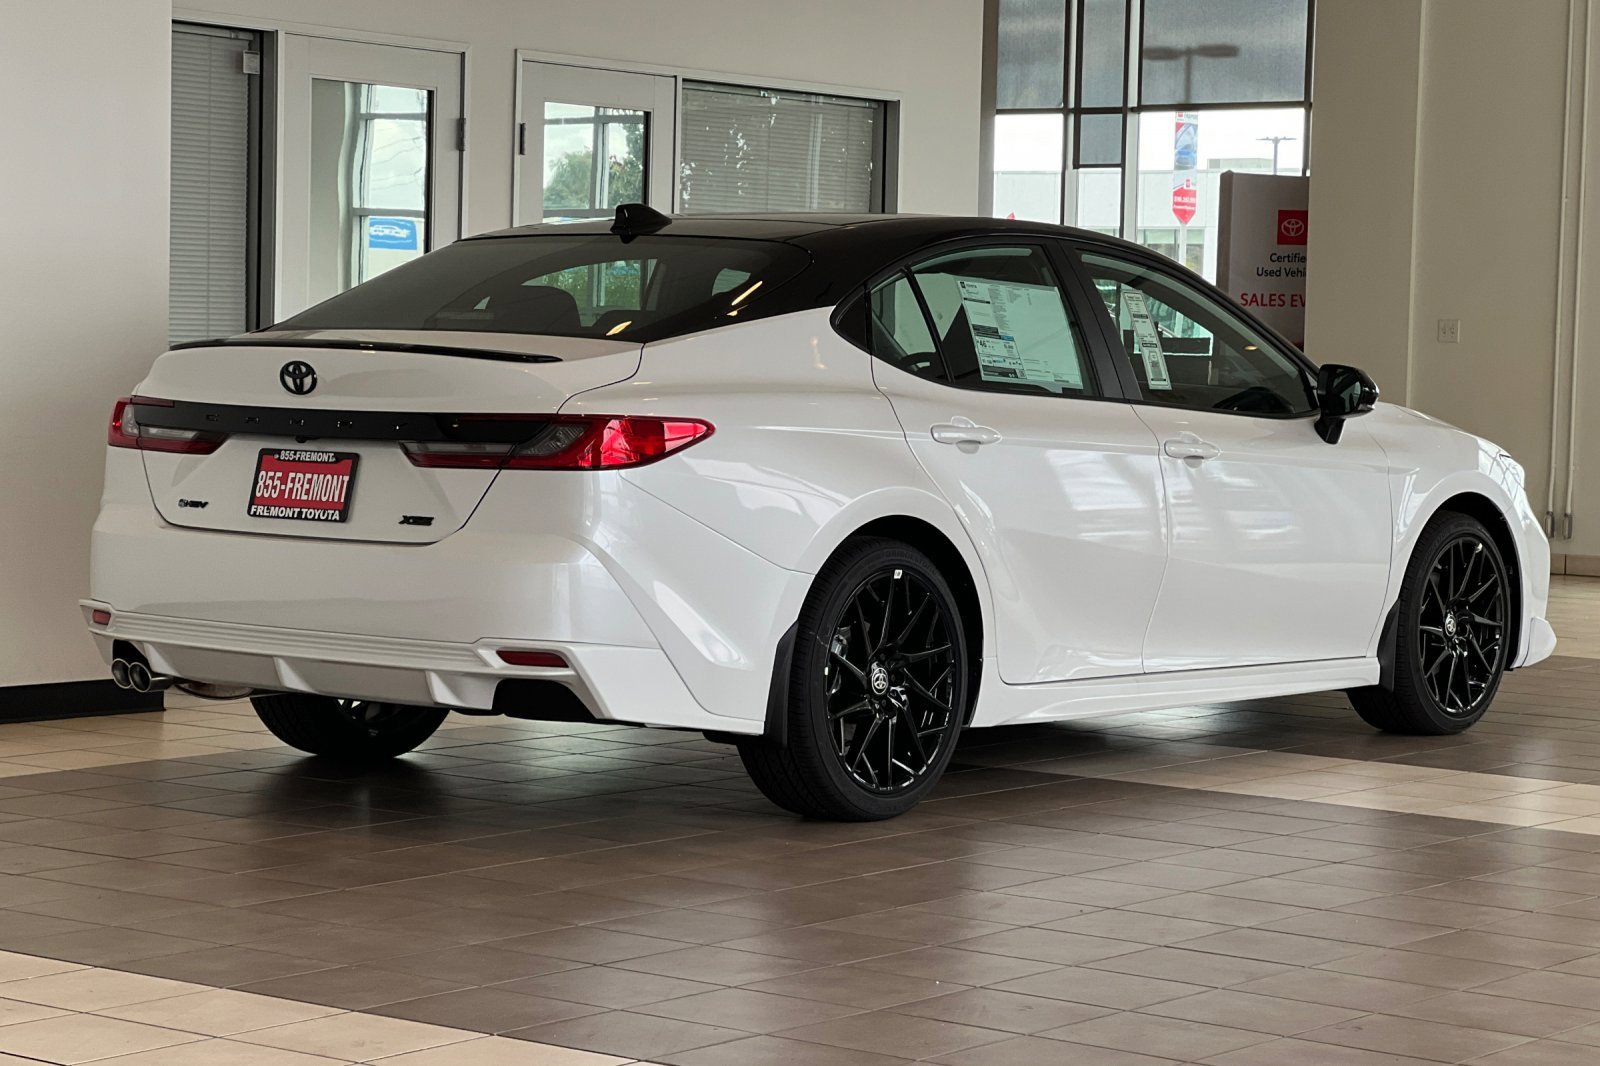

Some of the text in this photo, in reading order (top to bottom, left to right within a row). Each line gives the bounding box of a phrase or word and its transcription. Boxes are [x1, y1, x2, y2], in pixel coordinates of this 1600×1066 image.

[1256, 266, 1306, 277] Used Vehi
[1240, 292, 1286, 307] SALES
[280, 450, 334, 462] 855-FREMONT
[256, 470, 349, 502] 855-FREMONT
[250, 505, 340, 520] FREMONT TOYOTA
